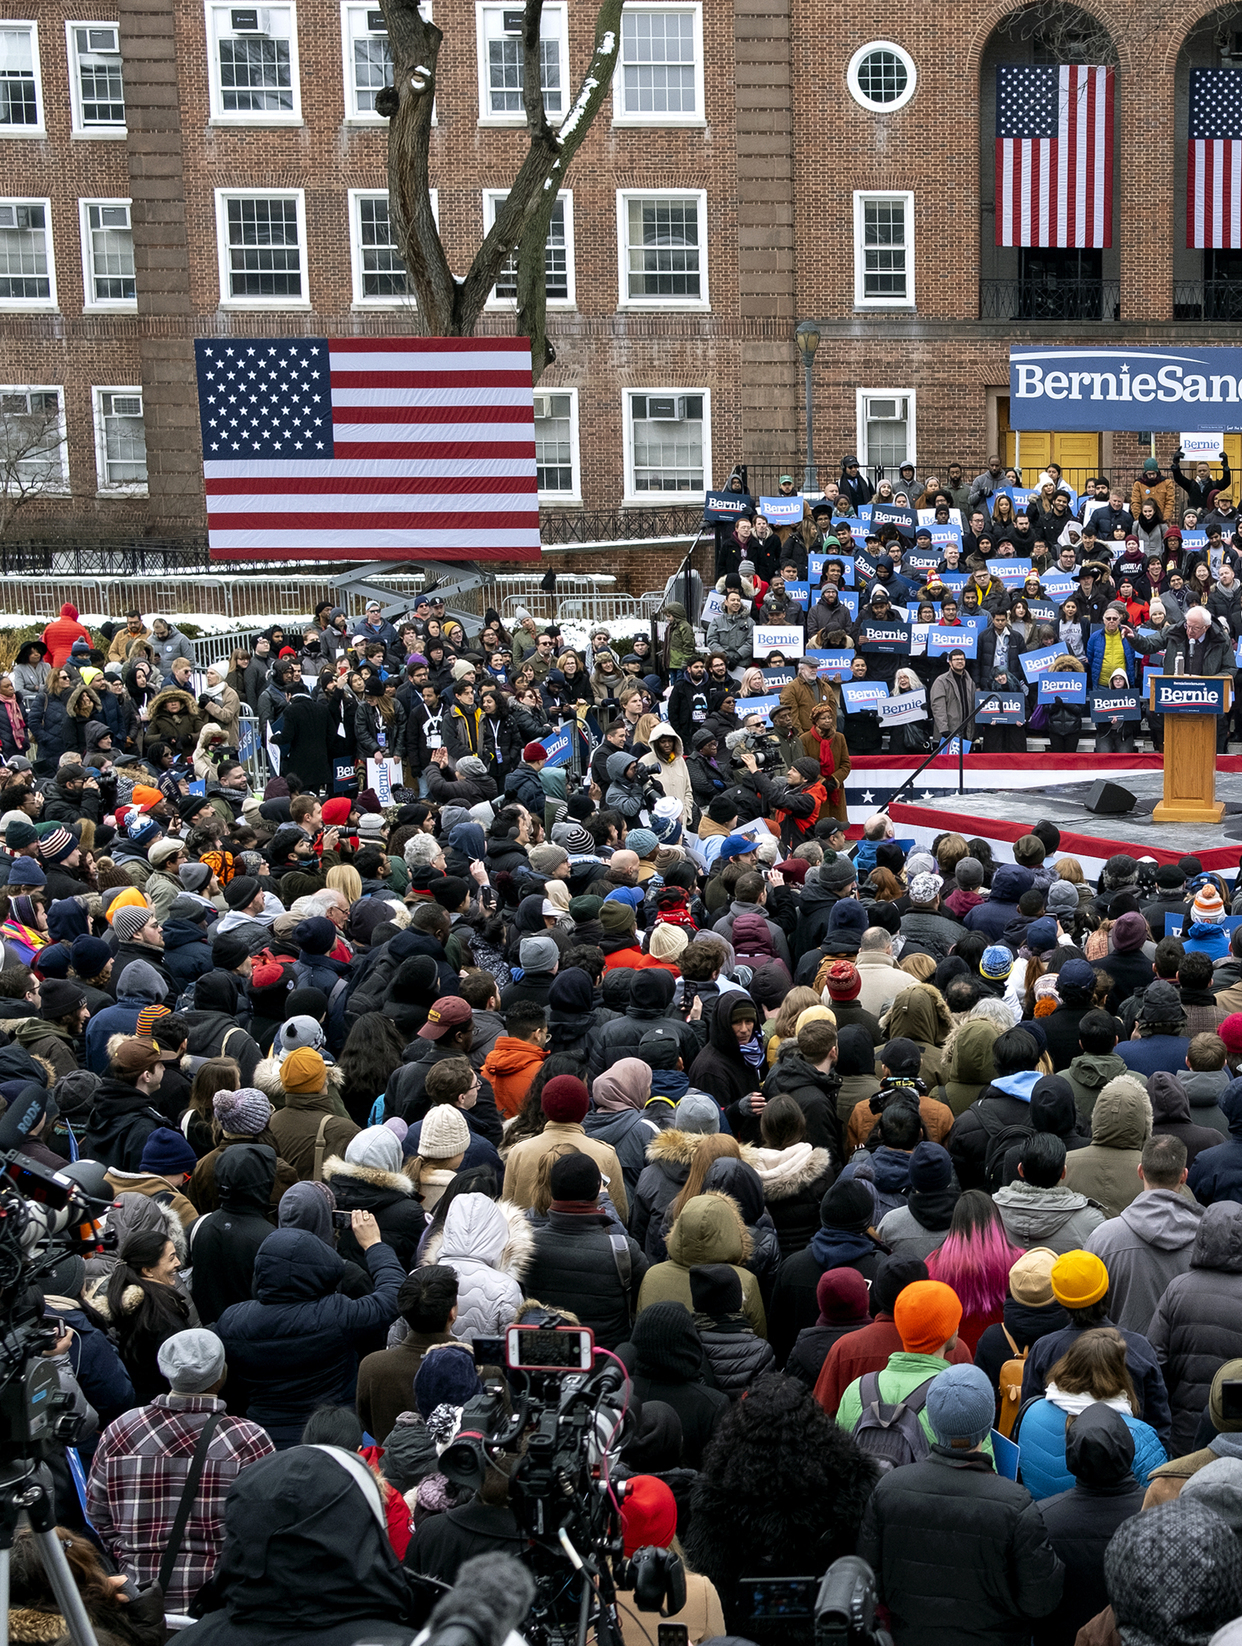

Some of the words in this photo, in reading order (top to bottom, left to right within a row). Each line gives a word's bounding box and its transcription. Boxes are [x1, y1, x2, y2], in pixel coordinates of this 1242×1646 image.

[1184, 439, 1220, 450] Bernie
[708, 498, 747, 511] Bernie
[763, 502, 801, 513] Bernie
[874, 510, 913, 525] Bernie
[990, 565, 1029, 577] Bernie
[758, 633, 800, 645] Bernie
[866, 627, 909, 641] Bernie
[932, 632, 974, 646] Bernie
[1041, 679, 1083, 692] Bernie
[847, 687, 887, 701] Bernie
[1160, 686, 1219, 703] Bernie
[882, 698, 922, 715] Bernie
[1094, 695, 1137, 710] Bernie
[376, 762, 389, 803] Bernie
